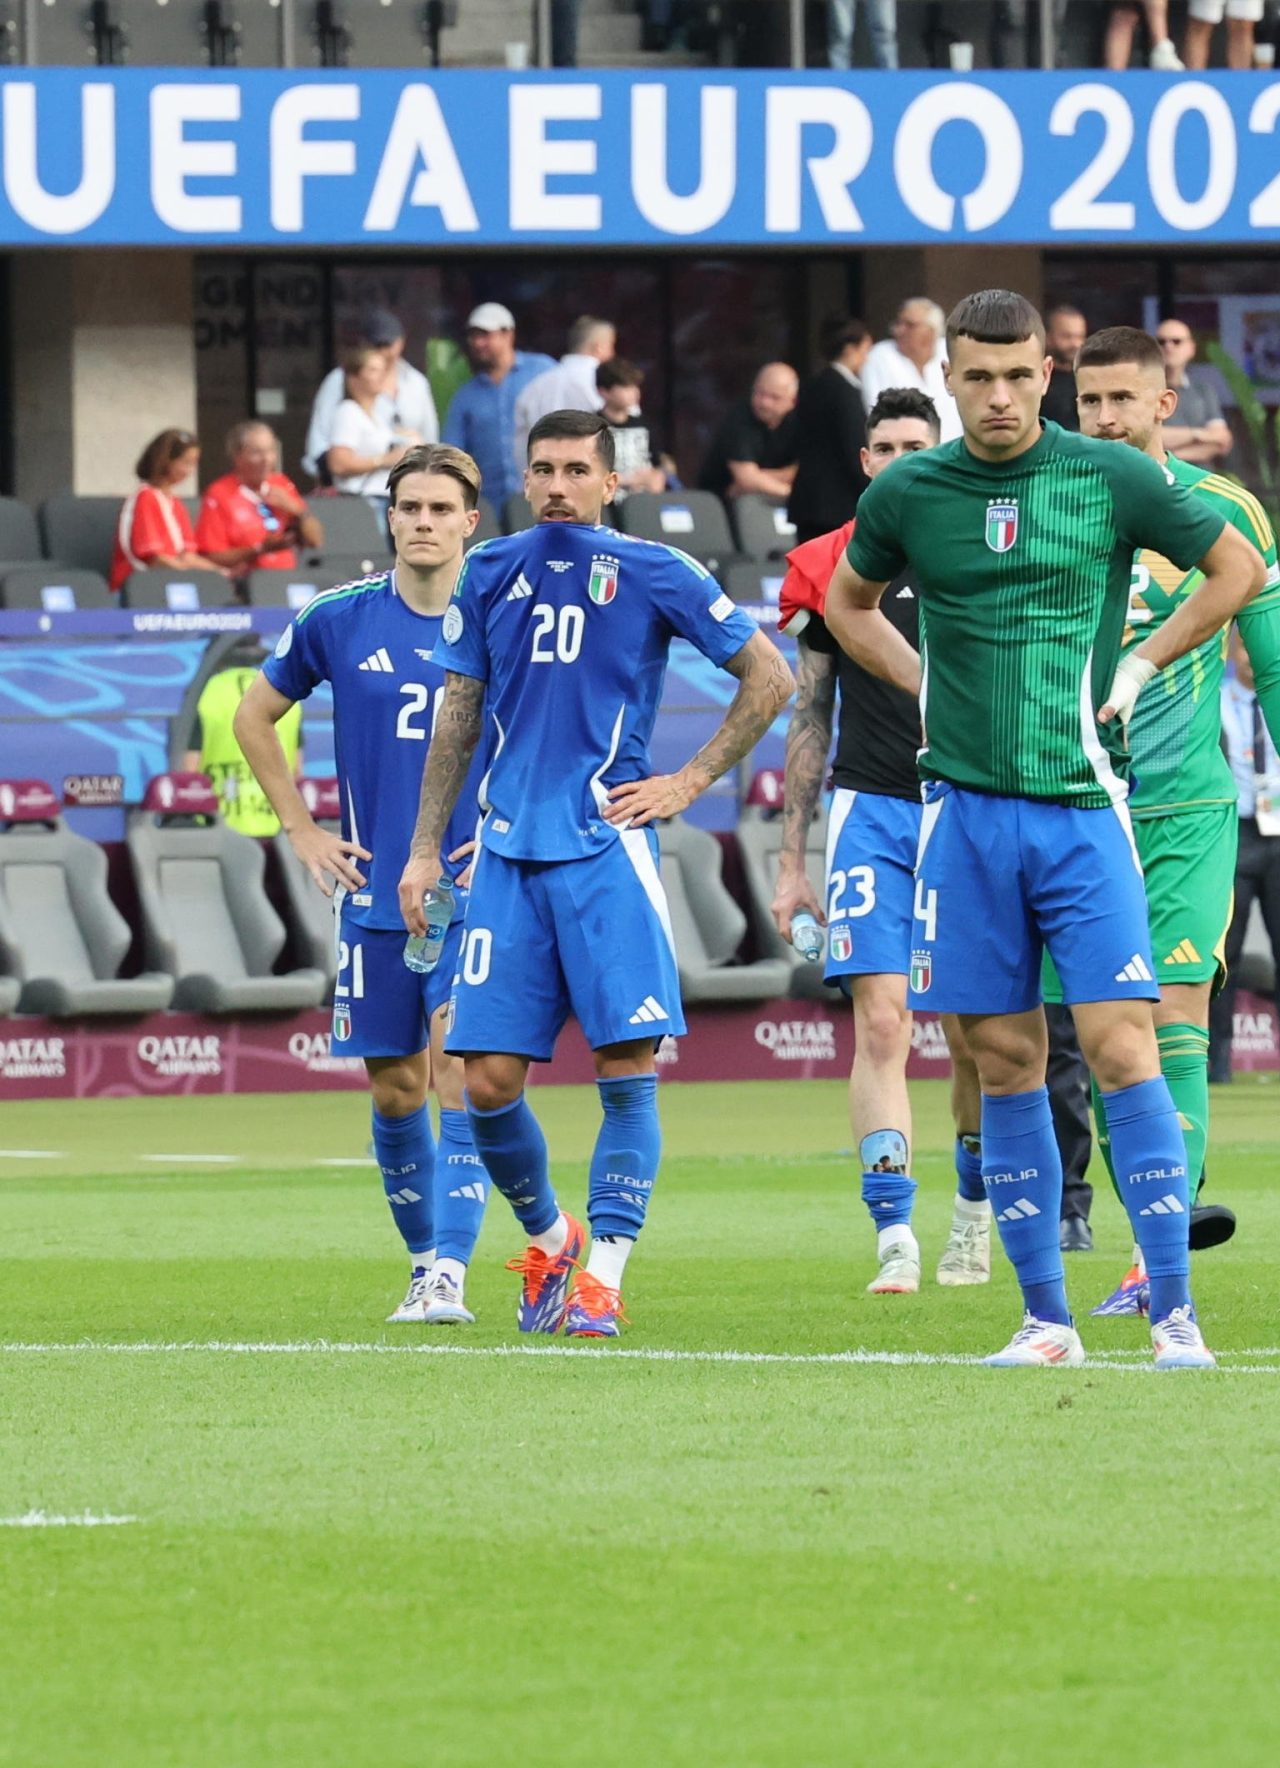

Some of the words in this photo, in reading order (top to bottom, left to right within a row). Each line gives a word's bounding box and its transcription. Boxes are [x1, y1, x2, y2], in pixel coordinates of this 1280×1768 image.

[990, 509, 1015, 520] ITALIA
[594, 564, 615, 575] ITALIA
[531, 604, 586, 664] 20
[396, 683, 445, 740] 2
[828, 865, 876, 923] 23
[913, 879, 938, 941] 4
[335, 941, 365, 999] 21
[755, 1021, 834, 1049] QATAR
[1232, 1013, 1273, 1036] TAR
[137, 1036, 221, 1065] QATAR
[983, 1168, 1039, 1186] ITALIA
[1129, 1166, 1186, 1184] ITALIA
